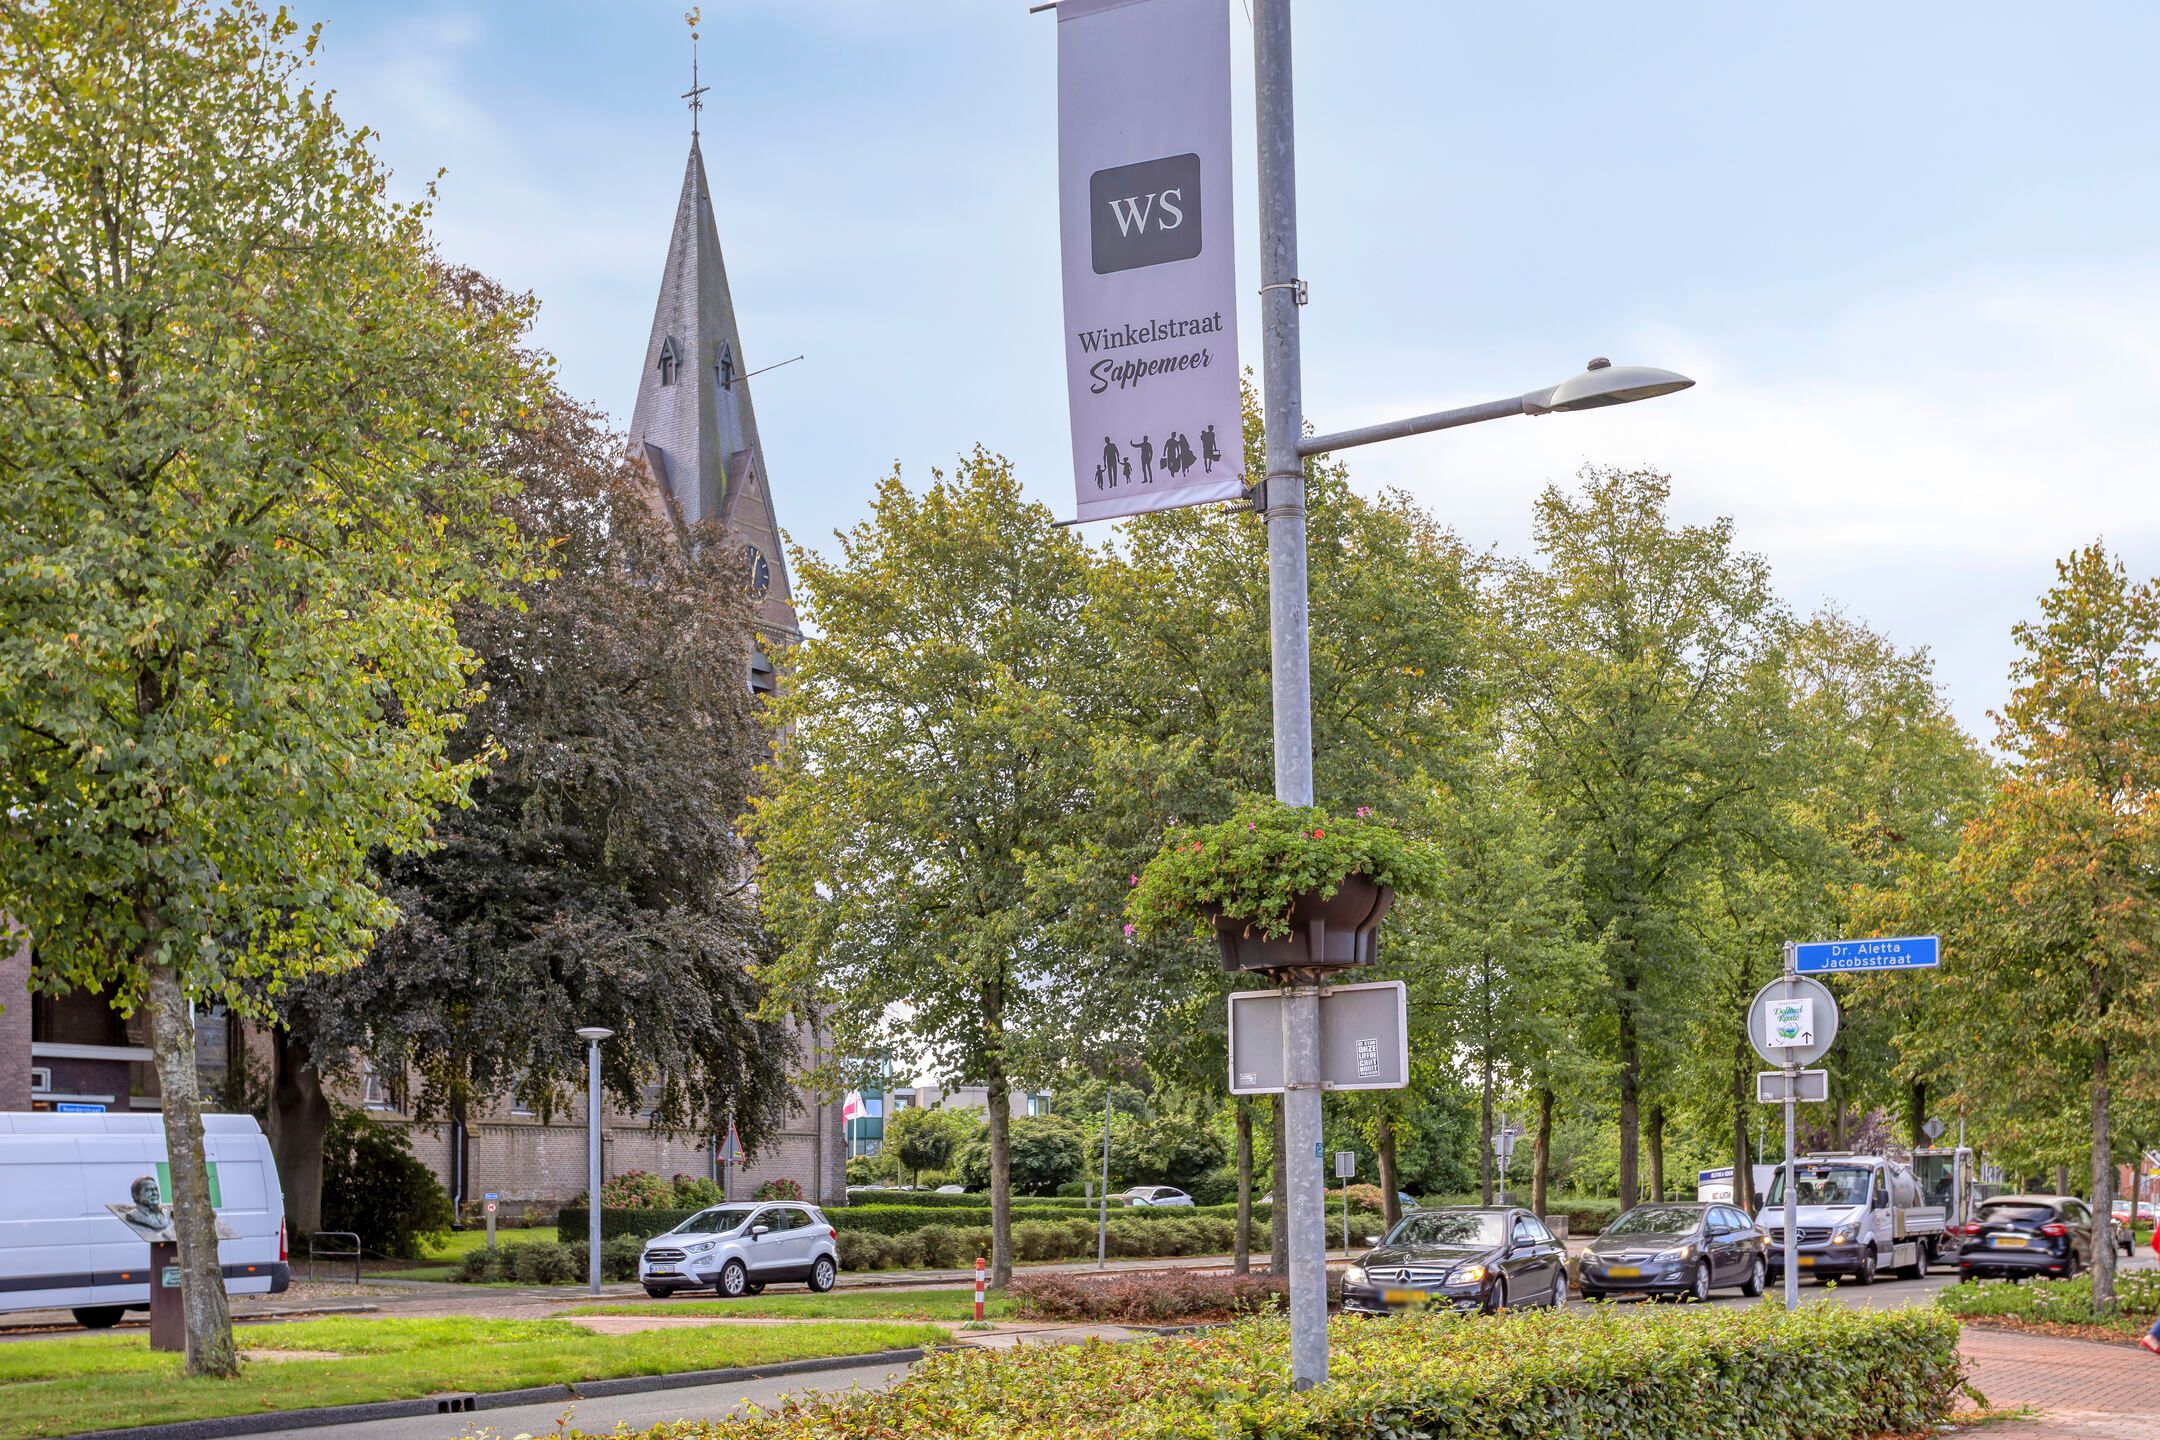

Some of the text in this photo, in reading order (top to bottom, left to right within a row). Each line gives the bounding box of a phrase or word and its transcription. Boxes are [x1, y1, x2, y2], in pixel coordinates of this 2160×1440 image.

[1108, 188, 1184, 238] WS
[1078, 311, 1223, 354] Winkelstraat
[1089, 348, 1214, 394] Sappemeer
[1821, 953, 1911, 968] Jacobsstraat
[1832, 943, 1900, 956] Dr. Aletta
